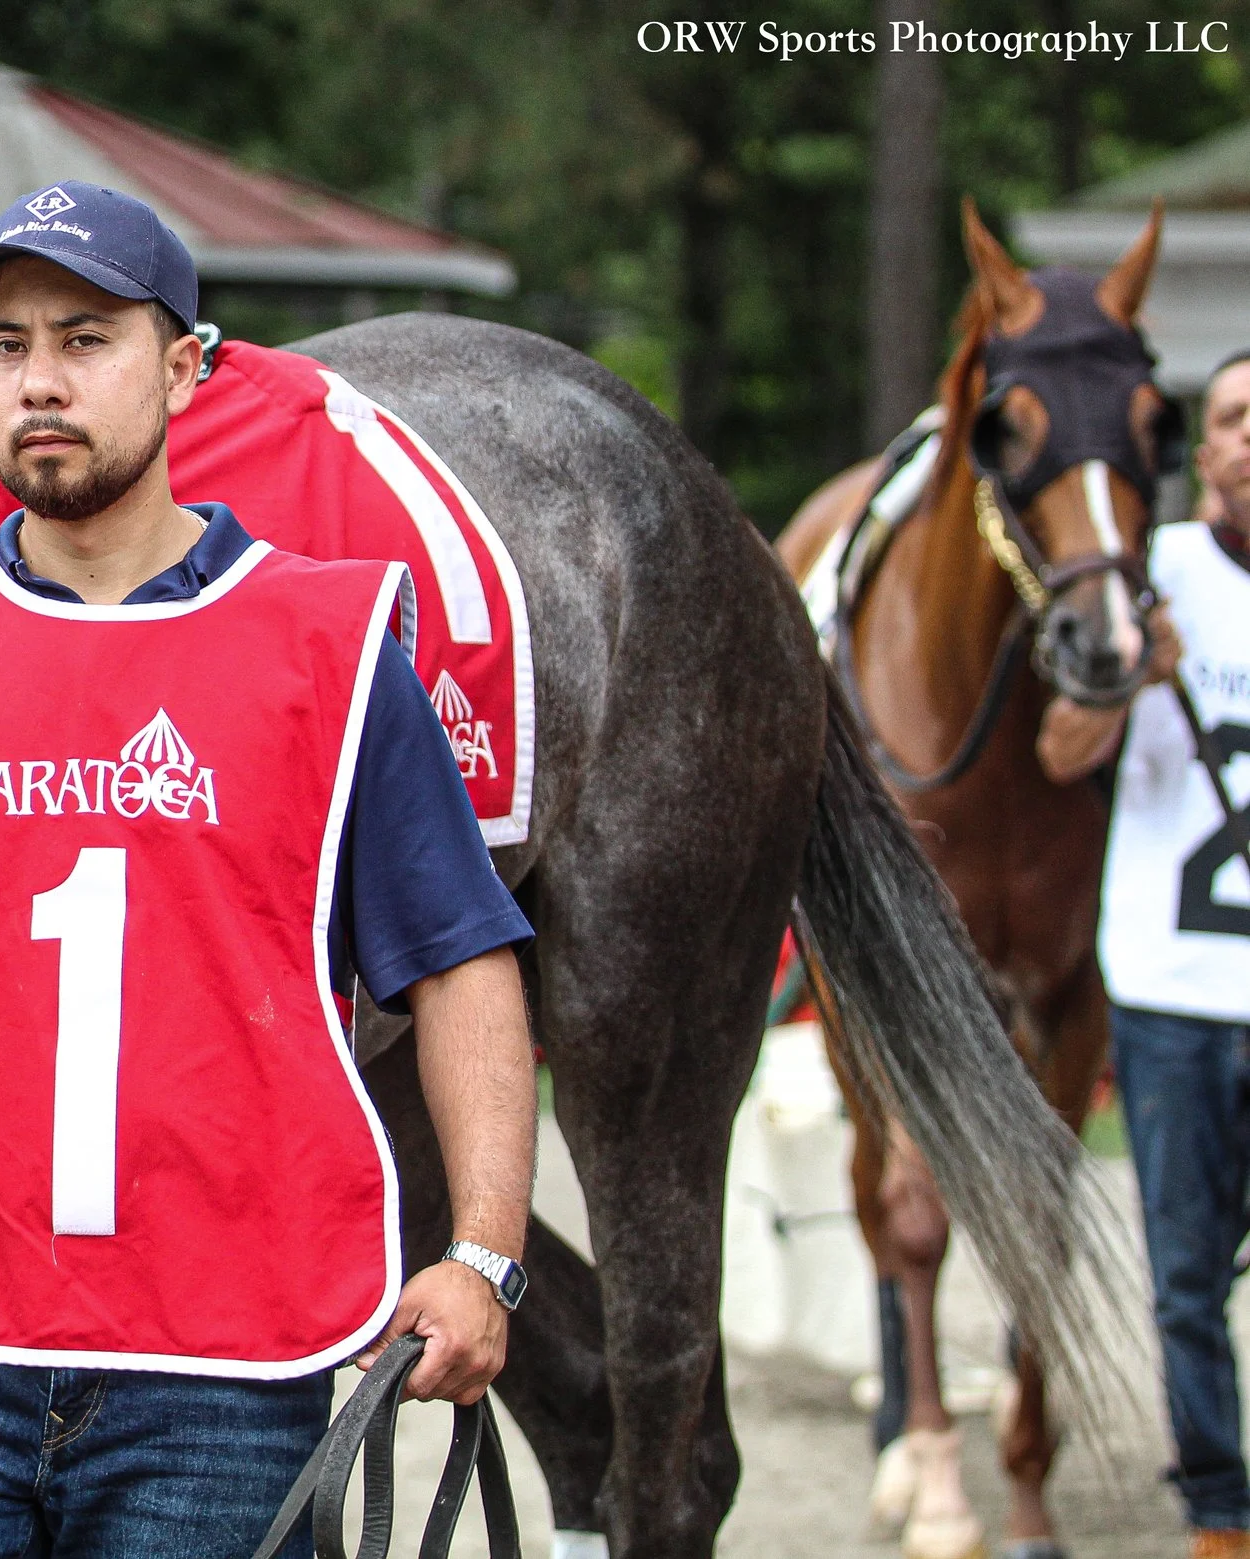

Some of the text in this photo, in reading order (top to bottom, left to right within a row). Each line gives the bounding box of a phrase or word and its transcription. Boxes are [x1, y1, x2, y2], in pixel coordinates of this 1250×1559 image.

[34, 197, 63, 210] LR
[24, 221, 51, 232] Rice
[51, 220, 92, 241] Racing
[31, 847, 127, 1236] 1
